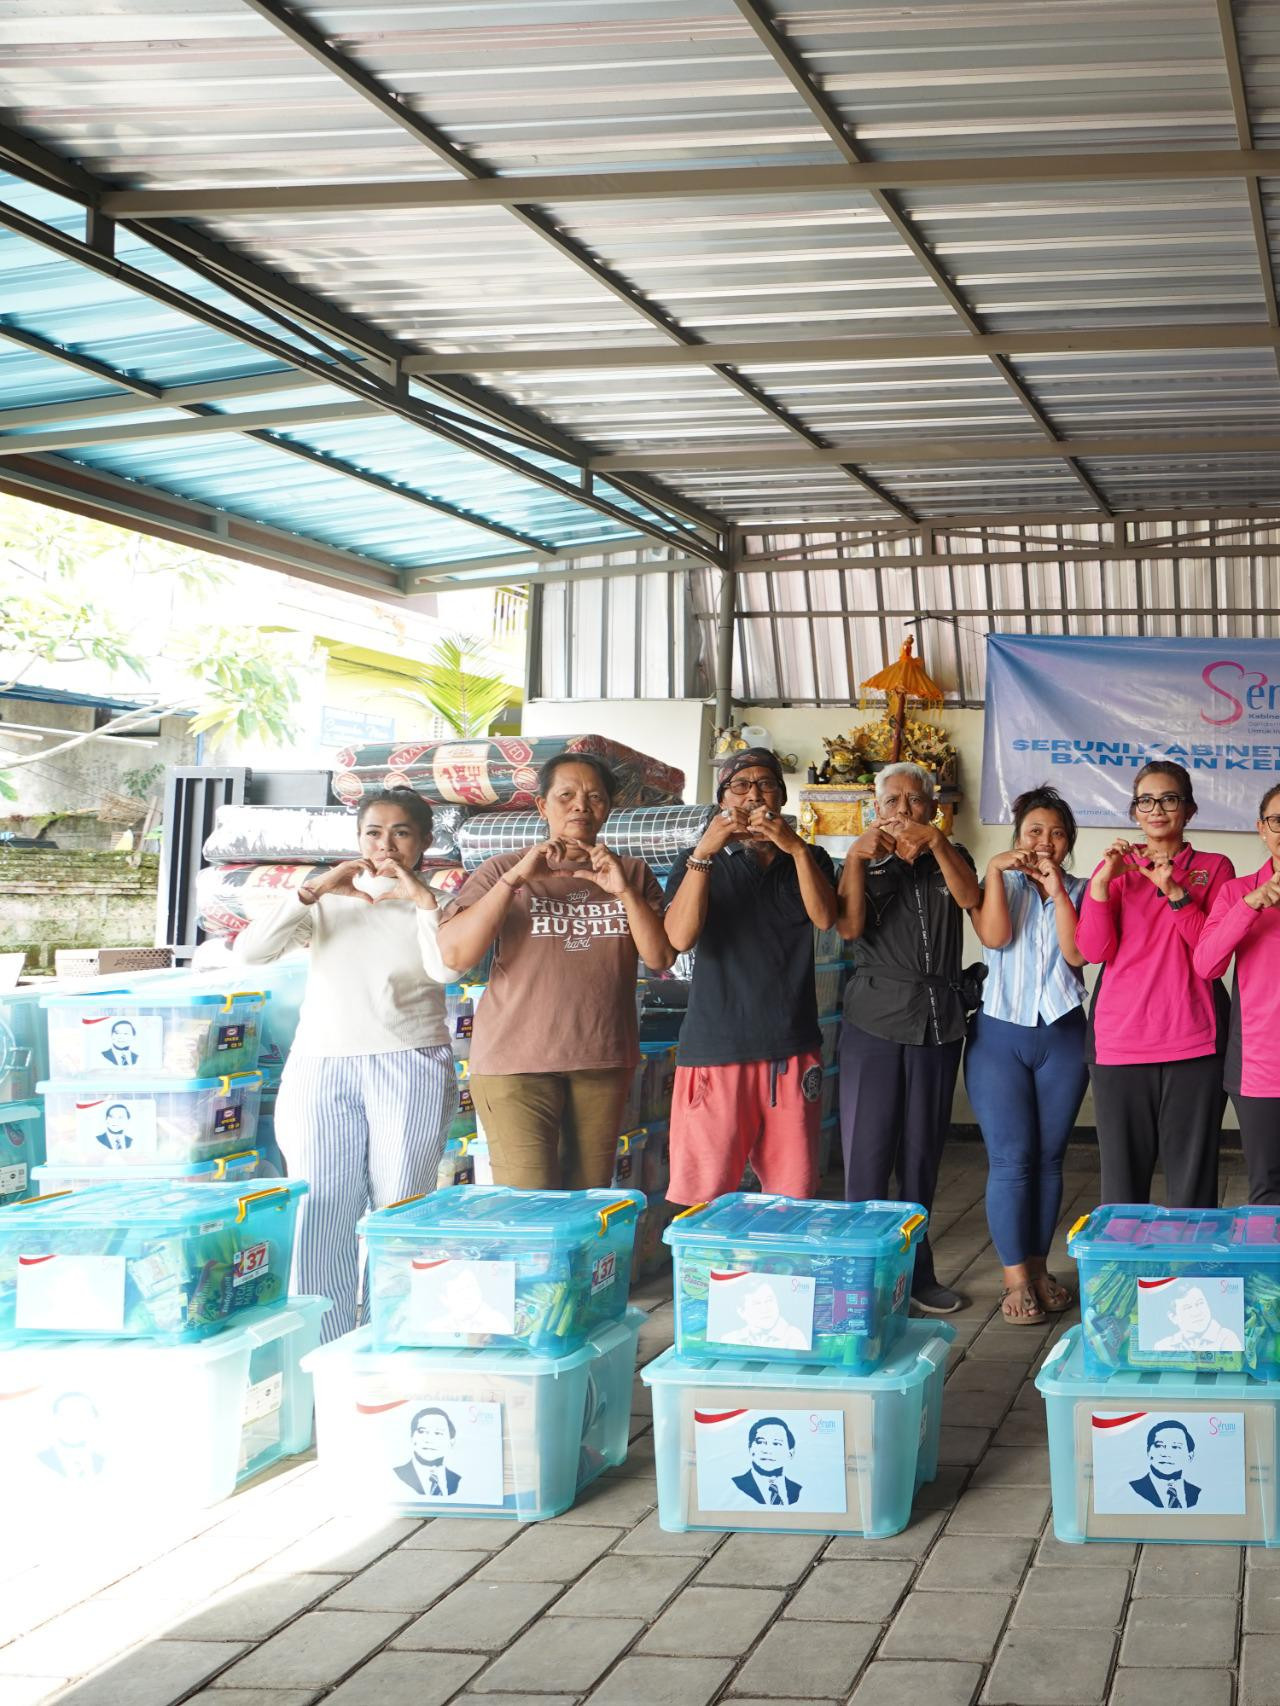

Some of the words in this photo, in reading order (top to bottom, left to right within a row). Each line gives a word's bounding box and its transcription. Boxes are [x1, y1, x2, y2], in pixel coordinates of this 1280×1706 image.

[1012, 739, 1131, 754] SERUNI
[530, 916, 630, 936] HUSTLE
[564, 935, 591, 949] hard
[247, 1247, 267, 1270] 37
[600, 1257, 615, 1279] 37
